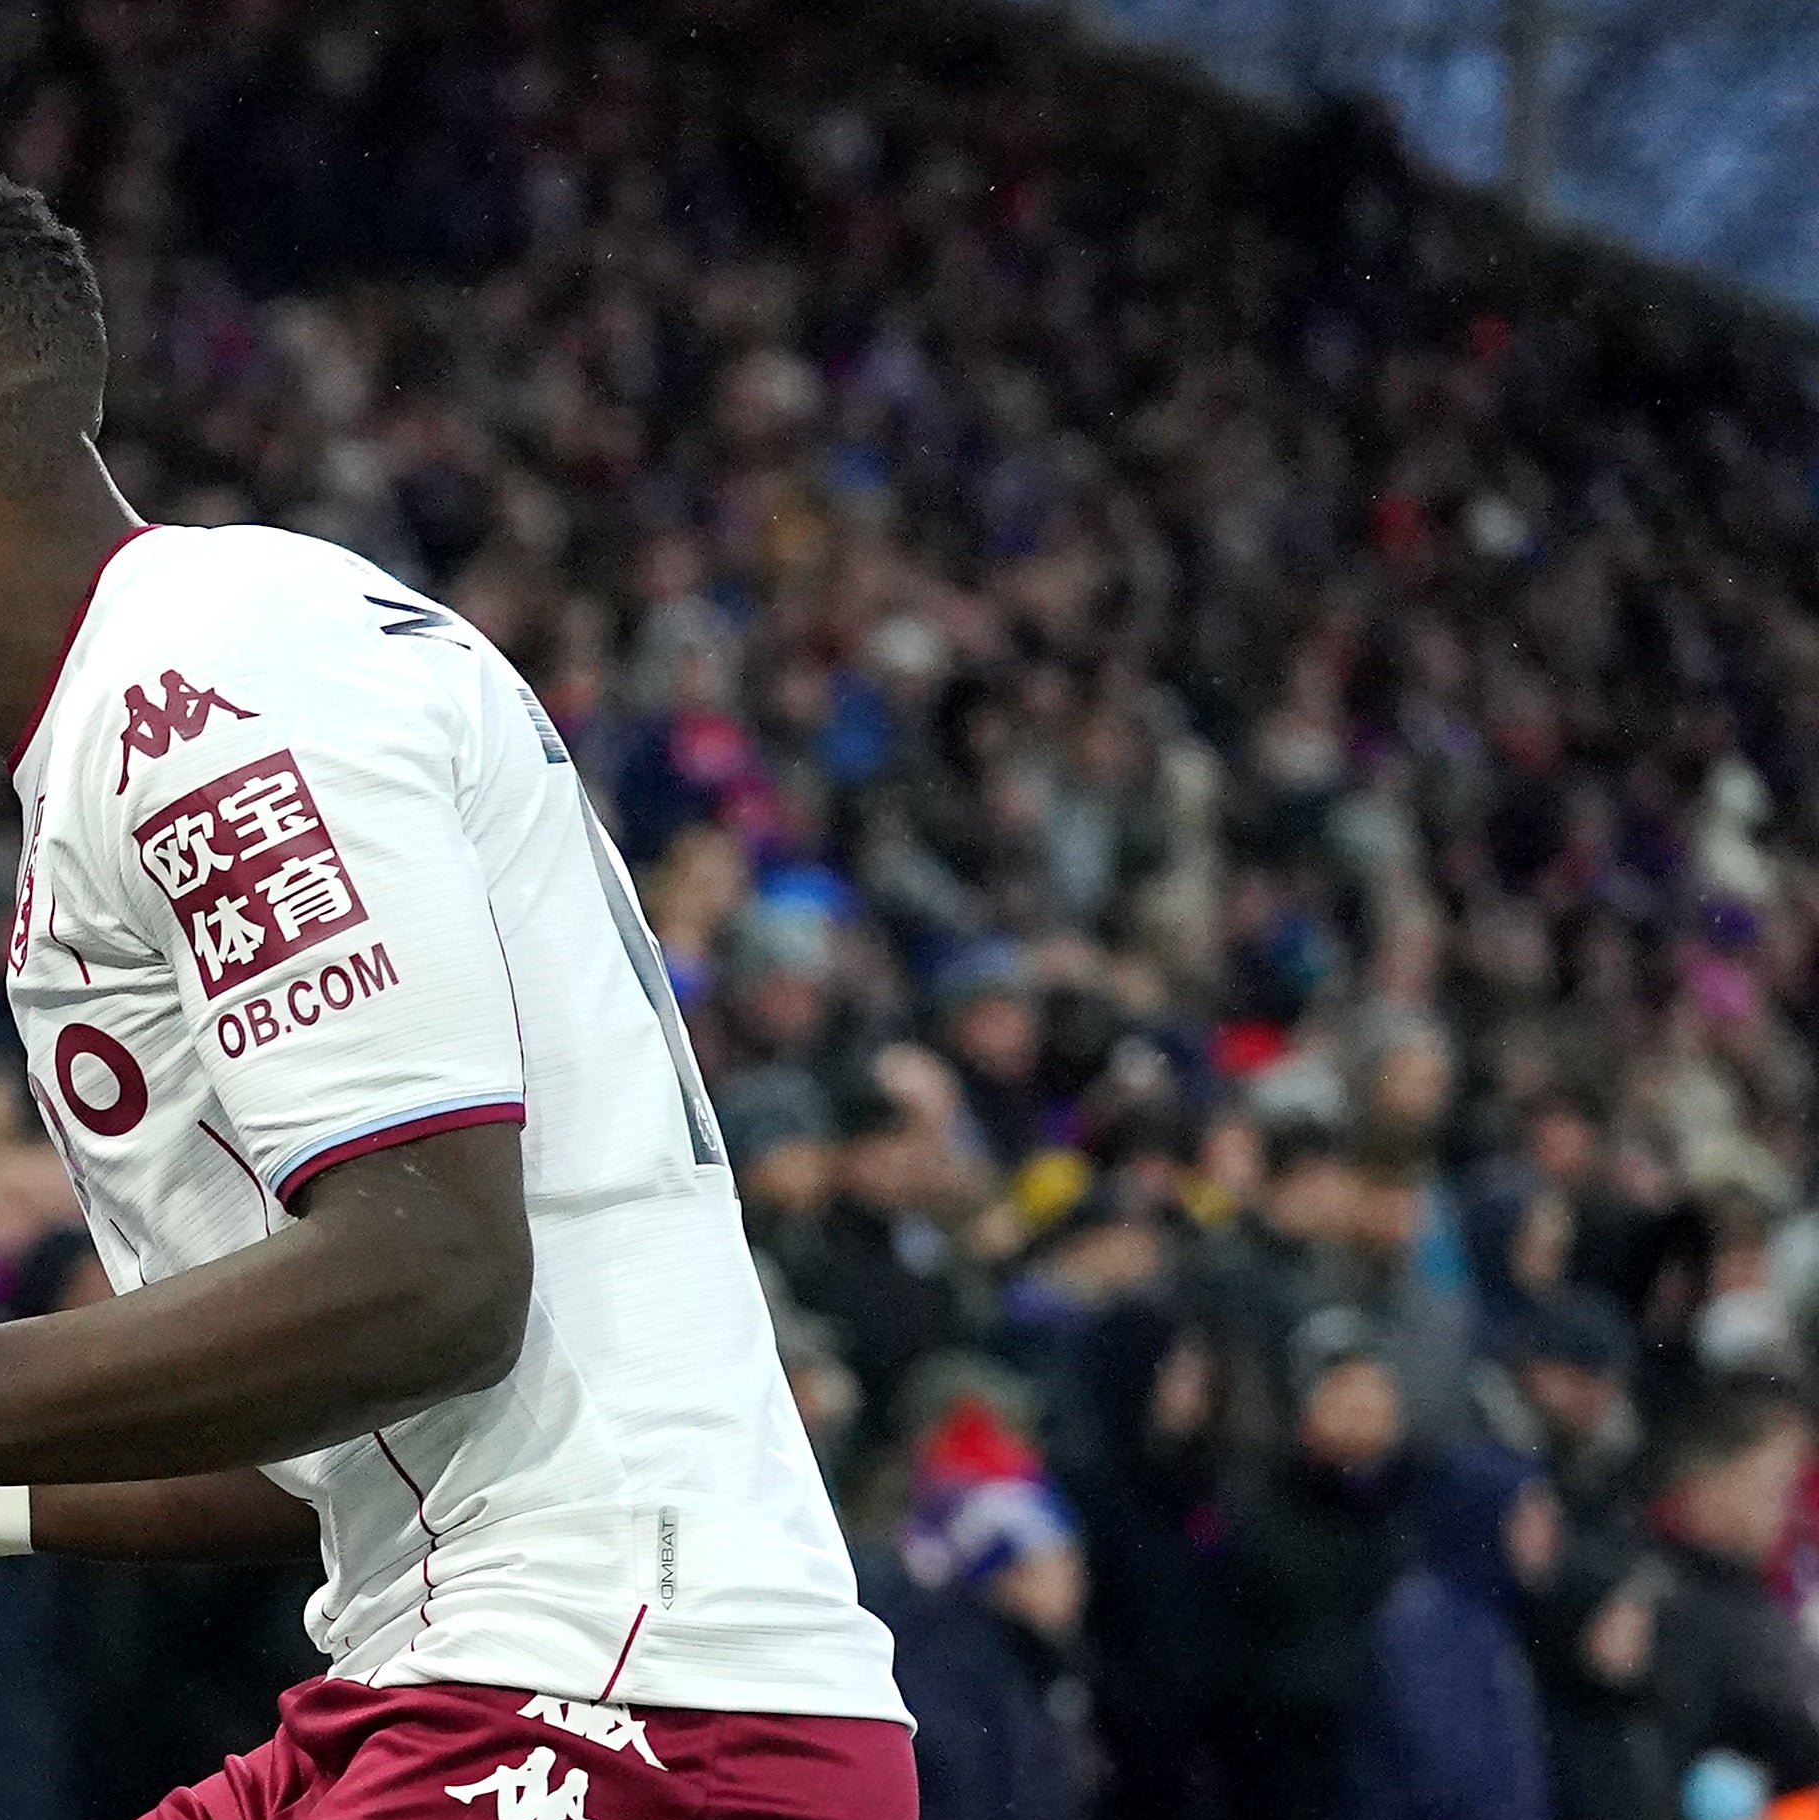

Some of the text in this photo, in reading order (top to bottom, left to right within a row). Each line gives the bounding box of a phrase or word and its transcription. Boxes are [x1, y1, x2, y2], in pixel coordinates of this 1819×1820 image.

[140, 769, 320, 900] 欧宝
[191, 847, 353, 984] 体育
[216, 941, 400, 1059] OB.COM
